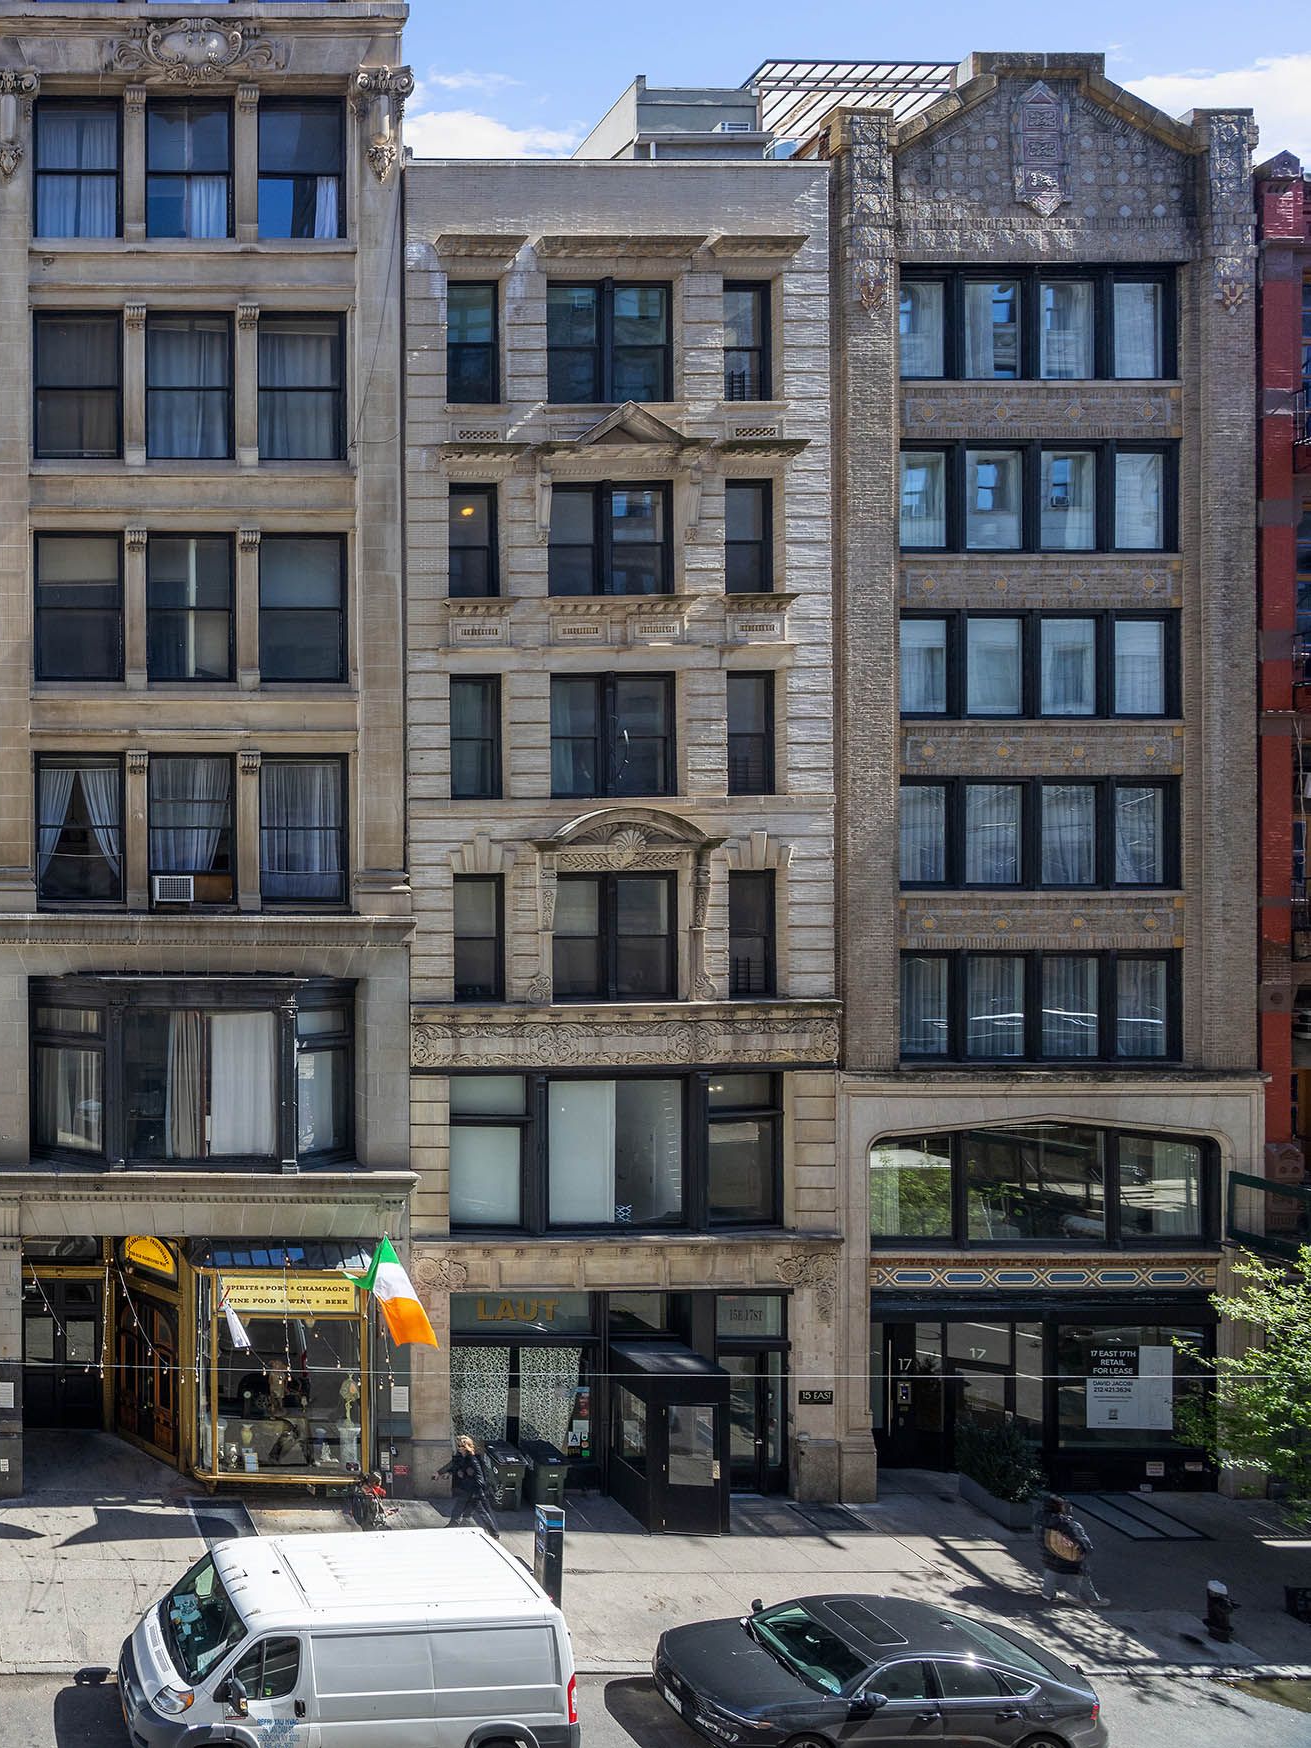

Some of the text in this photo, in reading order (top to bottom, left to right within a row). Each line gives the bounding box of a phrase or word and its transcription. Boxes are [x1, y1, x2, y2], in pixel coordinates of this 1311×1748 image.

[477, 1297, 560, 1322] LAUT
[970, 1348, 986, 1359] 17
[898, 1358, 912, 1370] 17
[802, 1392, 832, 1400] 15 EAST
[570, 1434, 578, 1442] A
